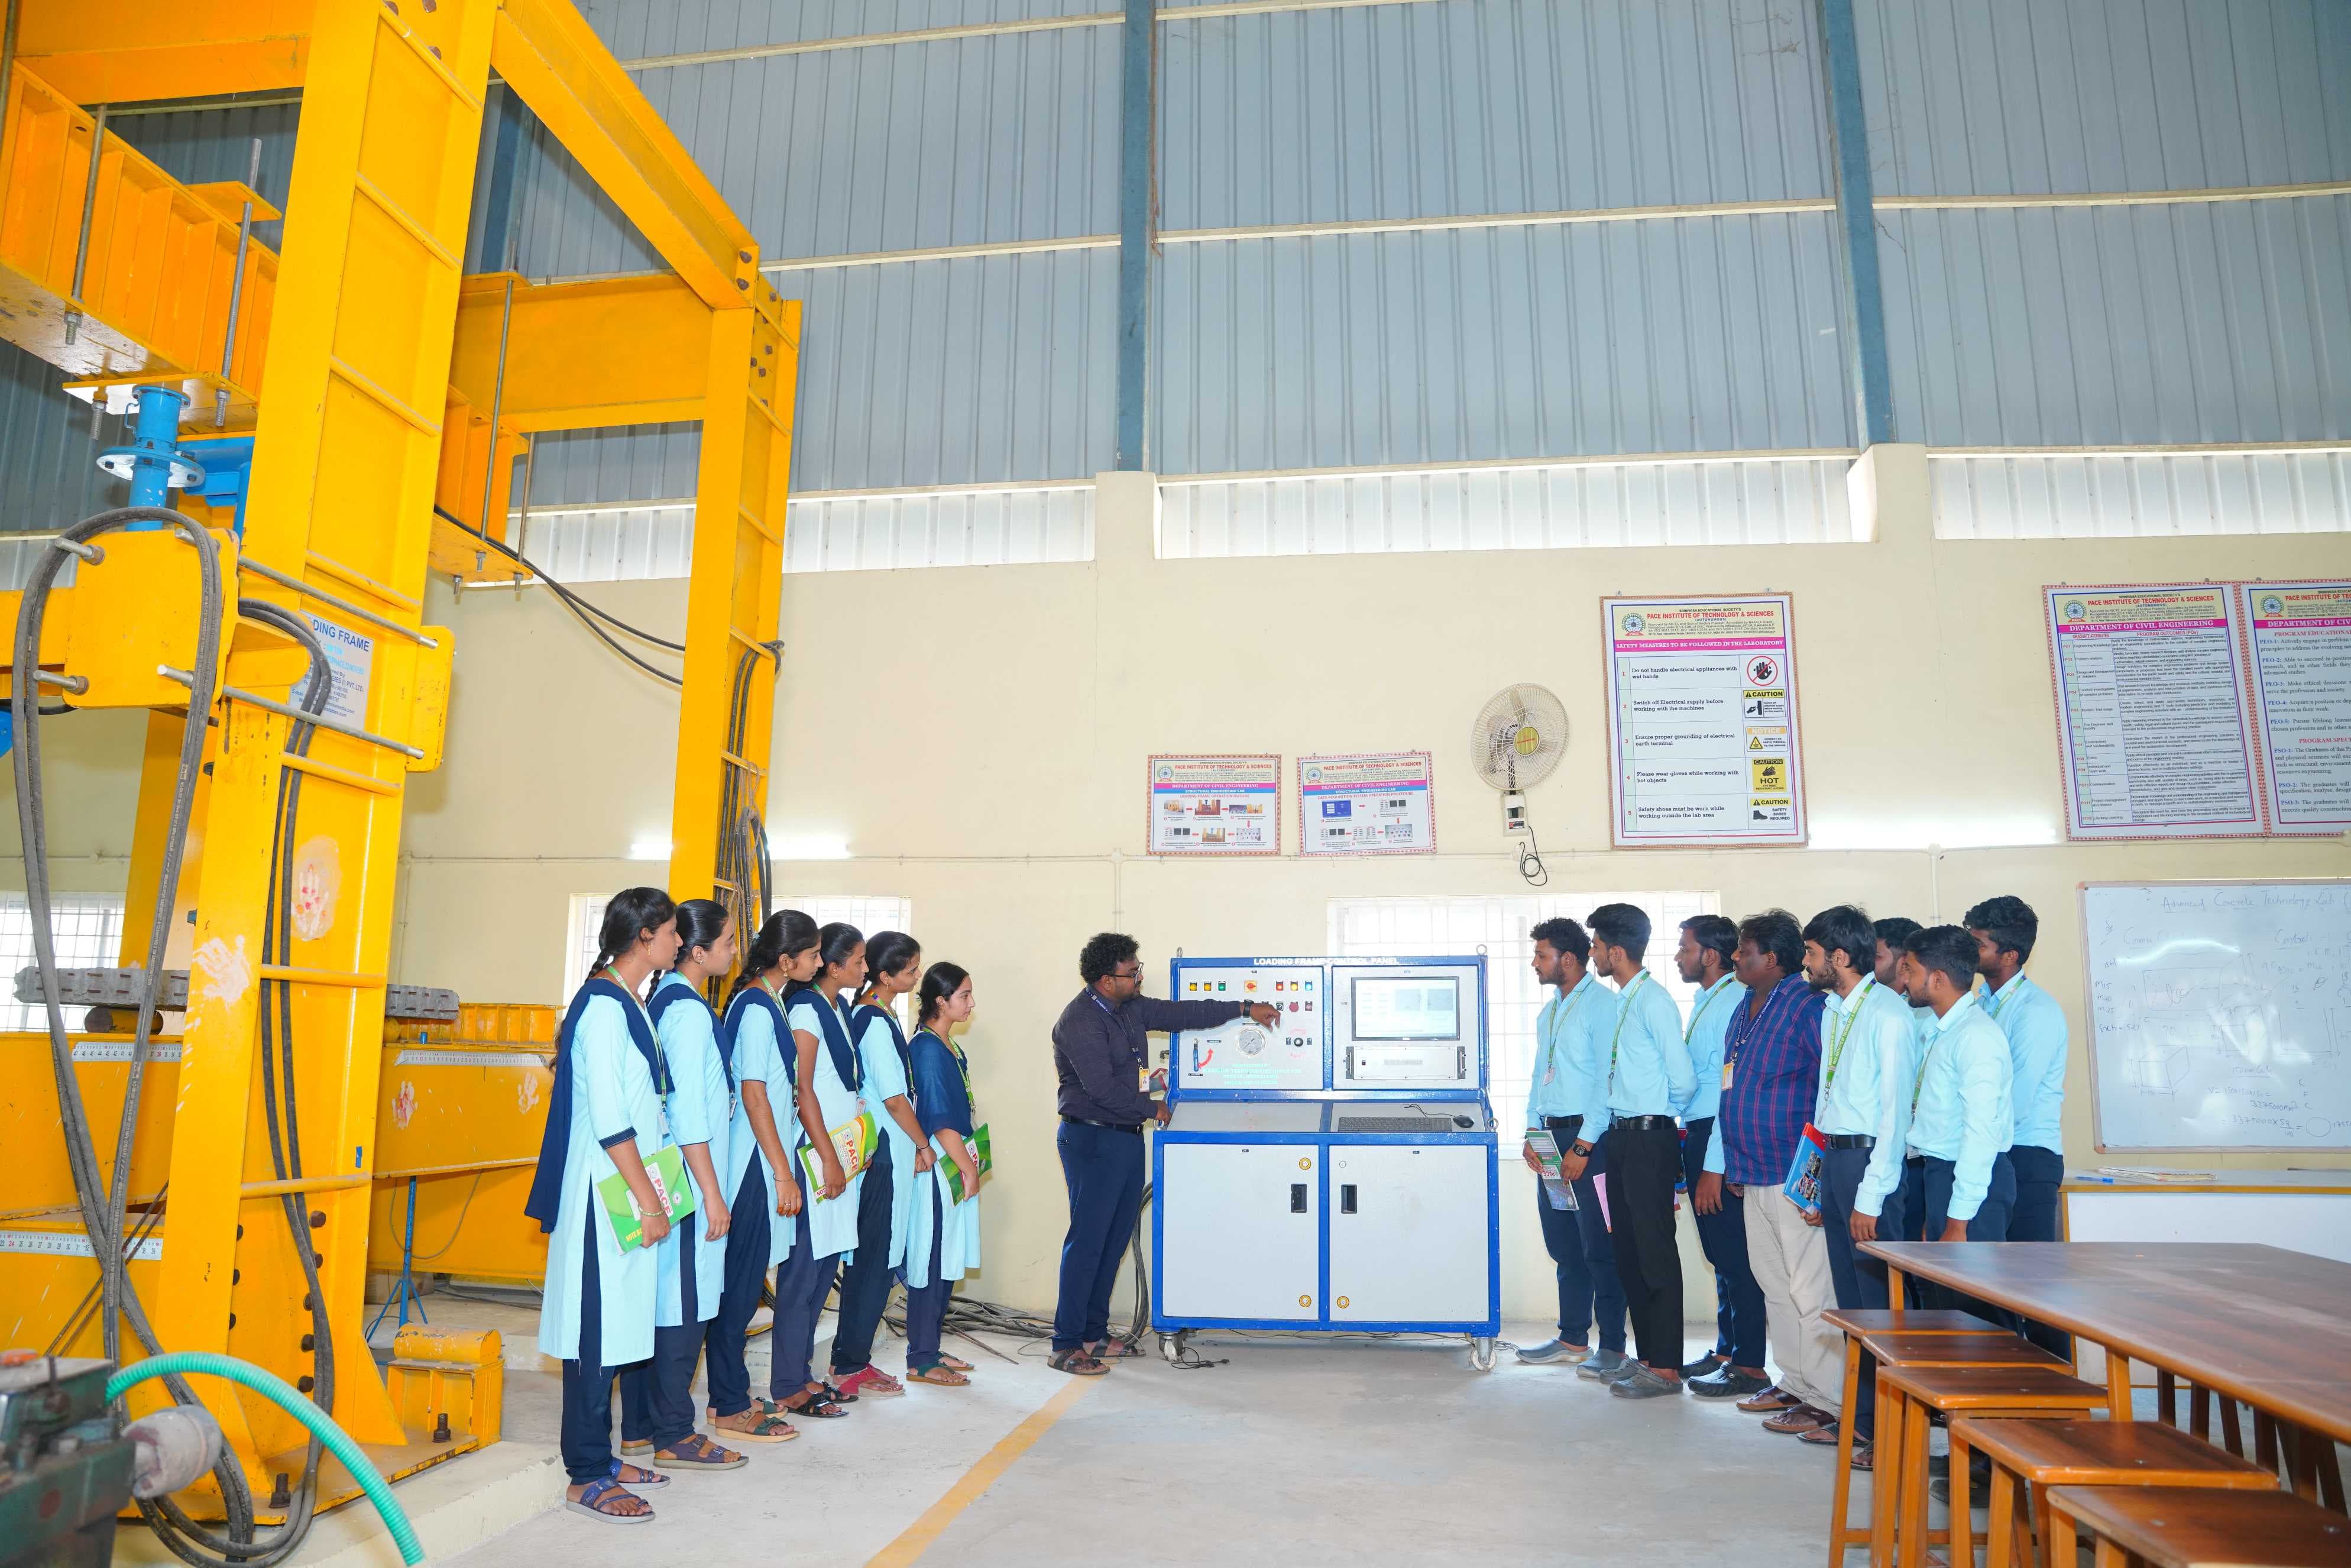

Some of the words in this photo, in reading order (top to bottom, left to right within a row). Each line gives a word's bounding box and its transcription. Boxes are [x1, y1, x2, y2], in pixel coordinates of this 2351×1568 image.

[313, 619, 336, 639] DING
[338, 630, 370, 652] FRAME
[846, 1139, 859, 1172] PACE
[655, 1178, 671, 1214] PACE
[817, 1188, 825, 1197] NOT
